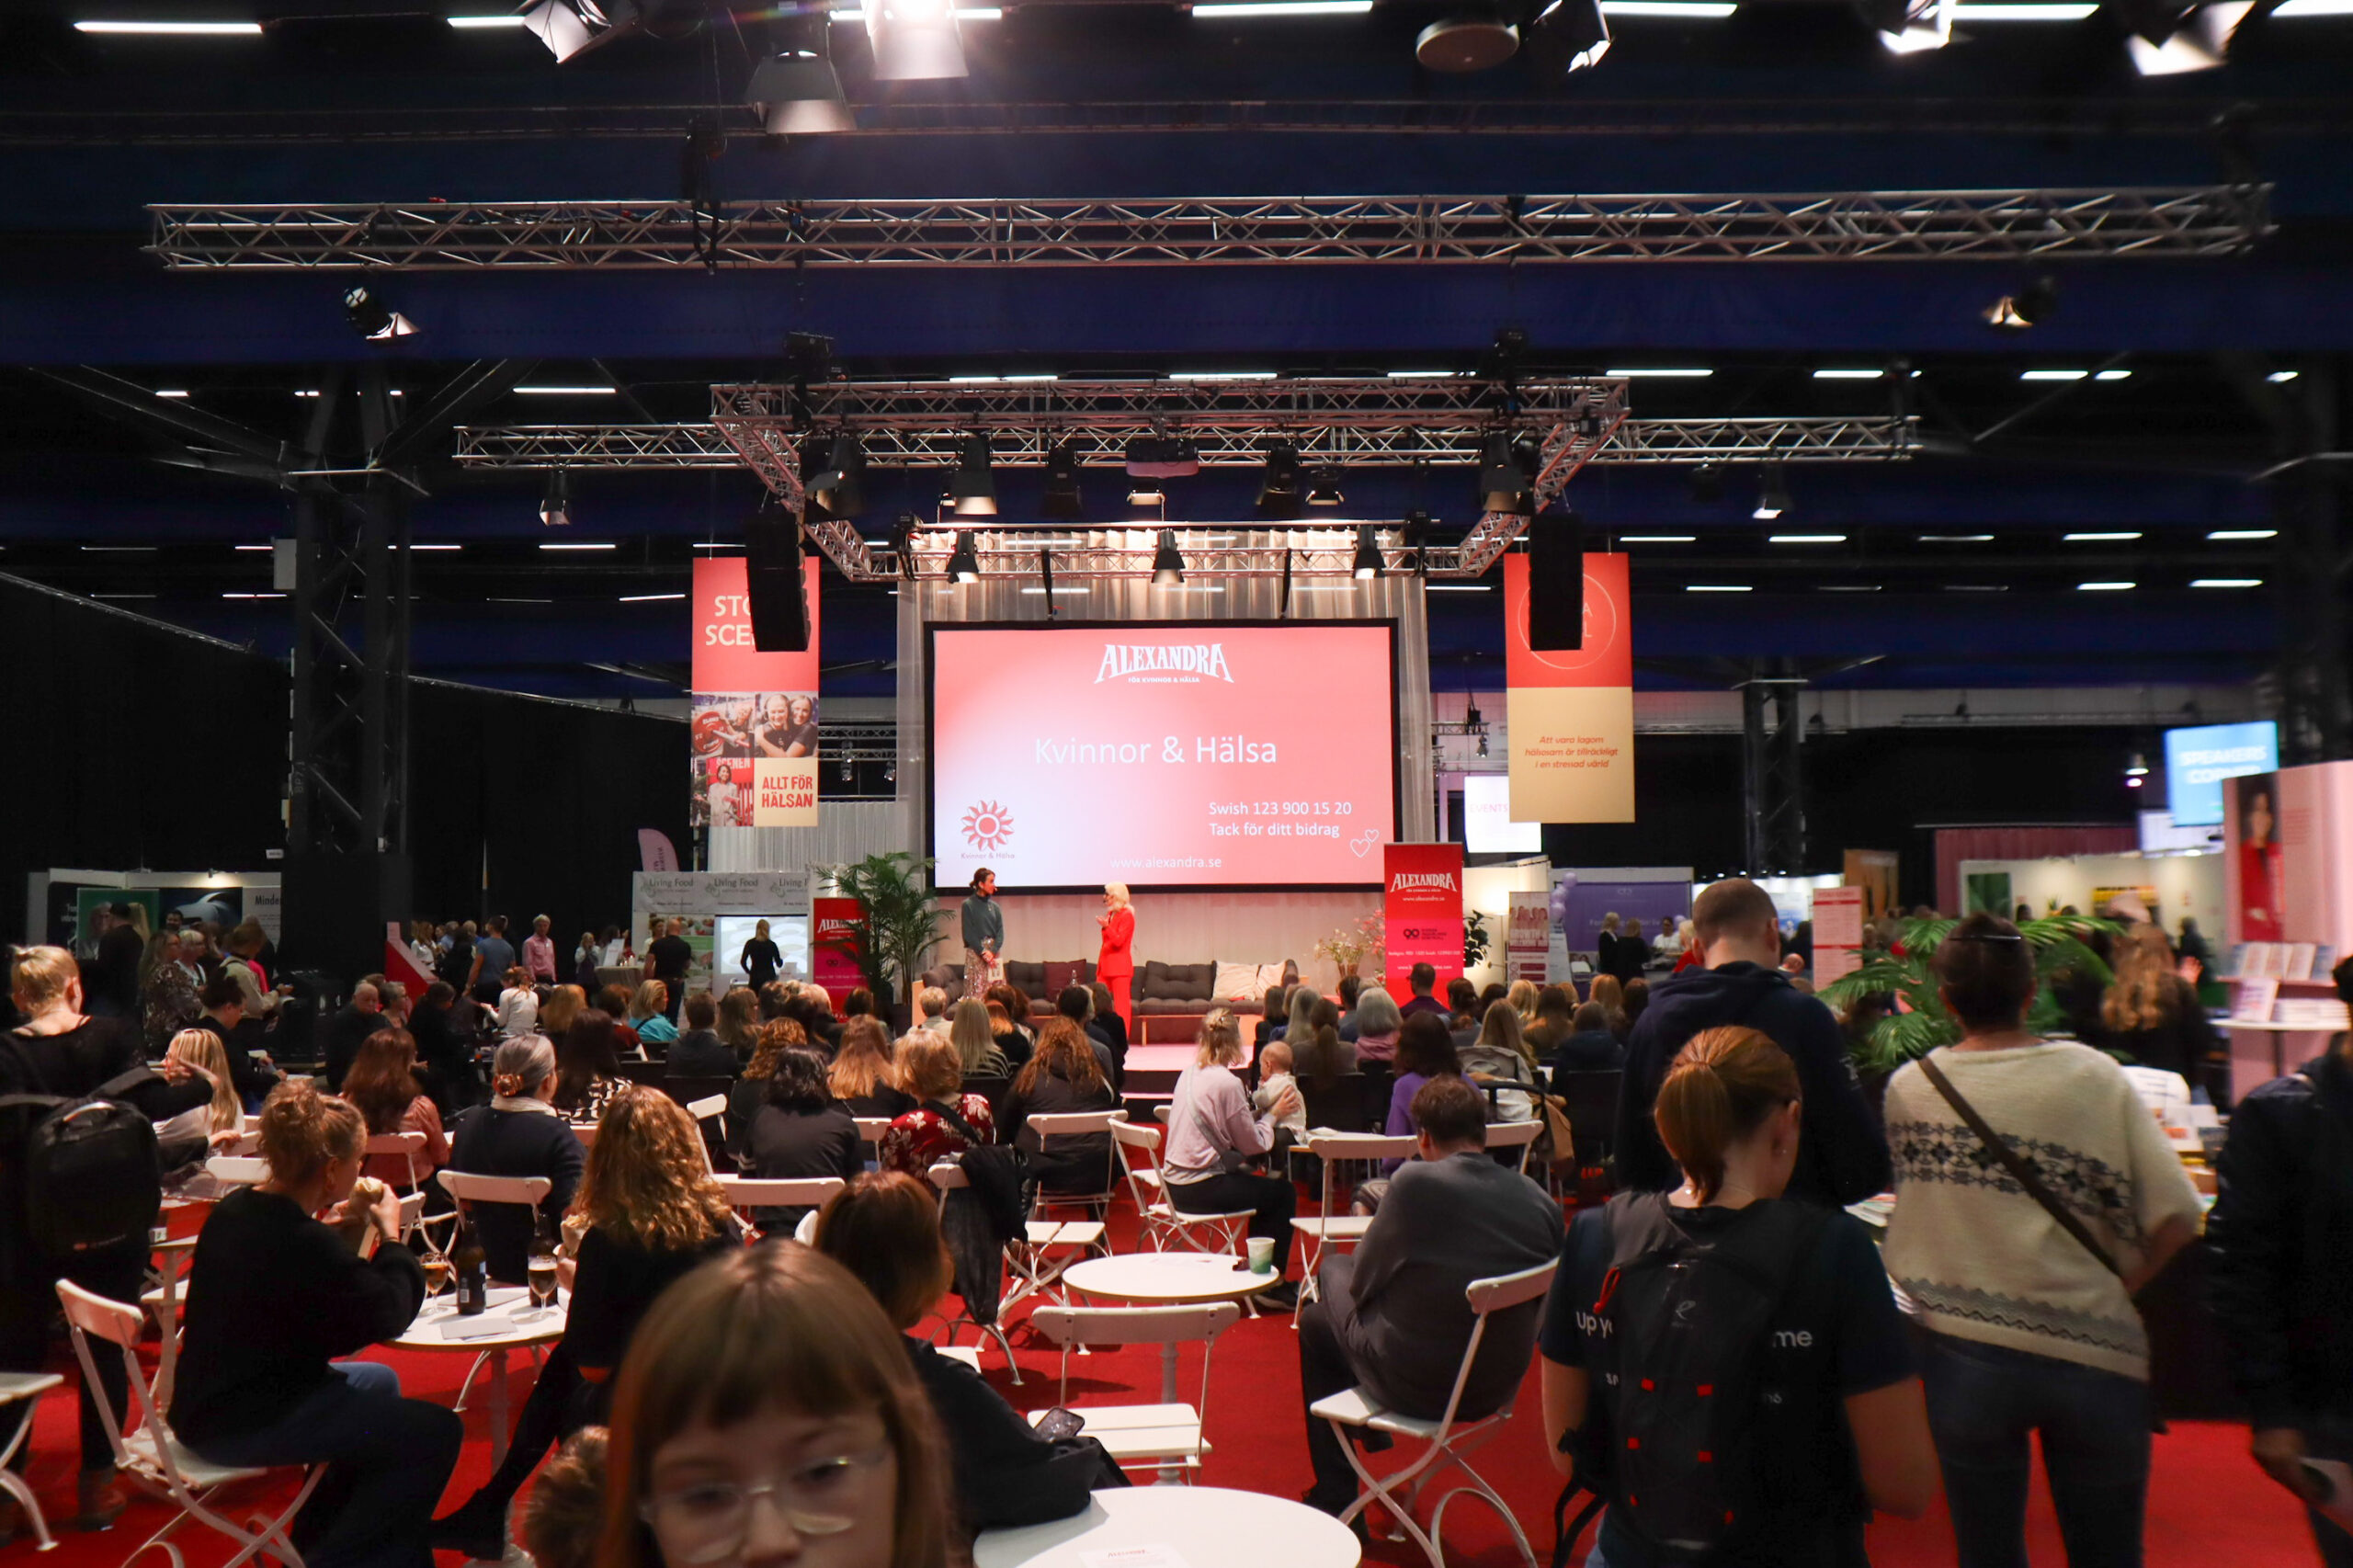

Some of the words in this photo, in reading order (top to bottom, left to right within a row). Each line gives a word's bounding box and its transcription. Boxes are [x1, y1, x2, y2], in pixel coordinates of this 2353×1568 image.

[705, 624, 756, 646] SCE
[1094, 643, 1234, 684] ALEXANDRA
[1035, 736, 1152, 764] Kvinnor
[1161, 735, 1186, 764] &
[1196, 734, 1277, 763] Hälsa
[761, 776, 789, 790] ALLT
[791, 775, 813, 790] FÖR
[761, 791, 813, 809] HÄLSAN
[1209, 801, 1249, 815] Swish
[1253, 801, 1279, 815] 123
[1282, 801, 1309, 815] 900
[1313, 801, 1330, 815] 15
[1335, 801, 1352, 815] 20
[1210, 823, 1240, 836] Tack
[1244, 822, 1264, 836] för
[1267, 823, 1292, 836] ditt
[1296, 823, 1340, 838] bidrag
[1110, 856, 1222, 869] www.alexandra.se
[1390, 872, 1457, 892] ALEXANDRA
[1575, 1311, 1597, 1336] Up
